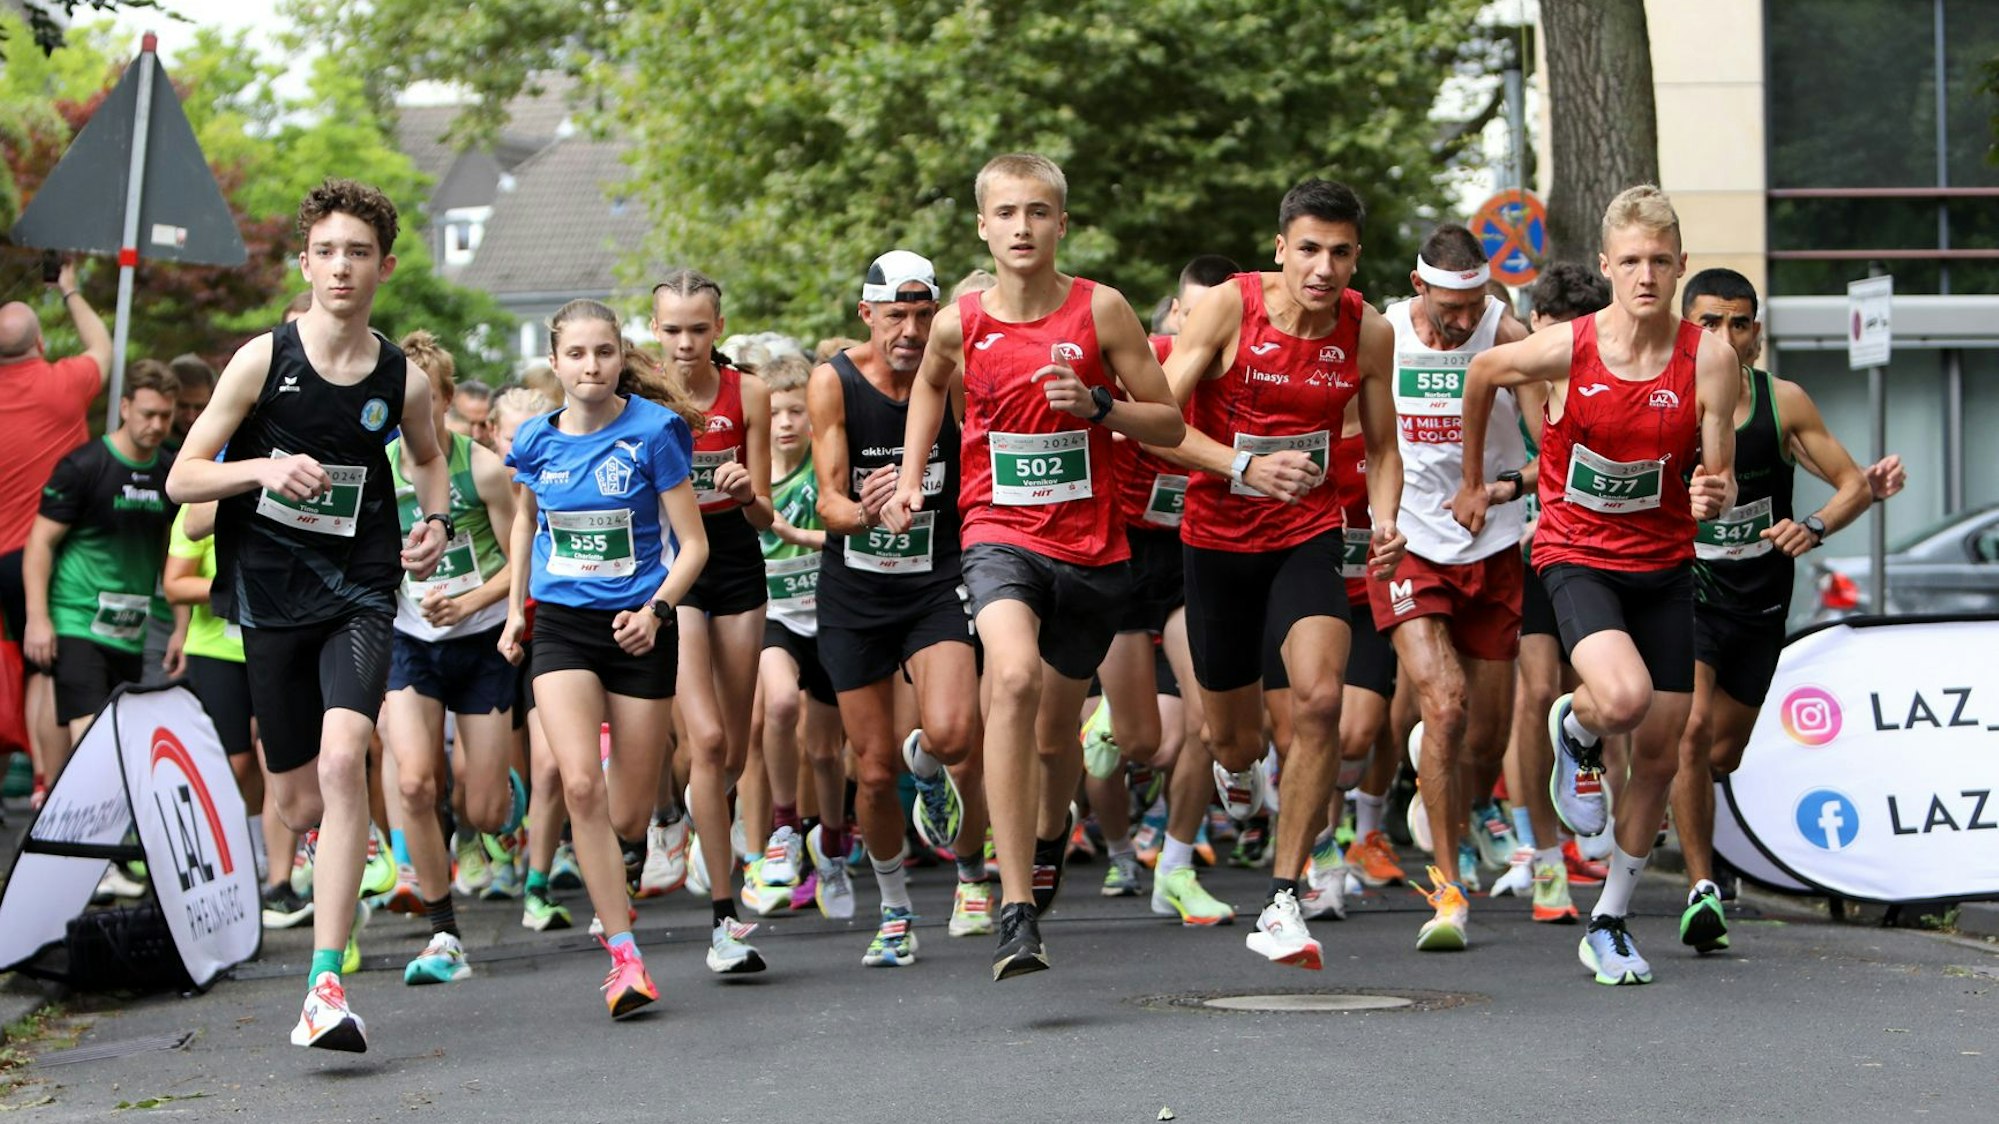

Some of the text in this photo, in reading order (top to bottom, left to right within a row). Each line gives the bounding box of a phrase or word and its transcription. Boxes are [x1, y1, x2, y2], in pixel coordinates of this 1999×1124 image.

[1252, 369, 1290, 386] inasys
[1417, 373, 1459, 390] 558
[1649, 394, 1669, 404] LAZ
[1043, 437, 1078, 449] 2024
[1289, 437, 1321, 449] 2024
[1016, 457, 1064, 477] 502
[1023, 479, 1058, 487] Vernikov
[1592, 474, 1638, 493] 577
[1032, 489, 1054, 497] HIT
[299, 504, 320, 514] Timo
[297, 515, 320, 525] HIT
[588, 516, 622, 527] 2024
[1713, 522, 1754, 540] 347
[570, 533, 608, 553] 555
[868, 532, 911, 550] 573
[573, 552, 604, 562] Charlotte
[783, 571, 819, 592] 348
[1887, 788, 1999, 836] LAZ
[154, 784, 215, 893] LAZ
